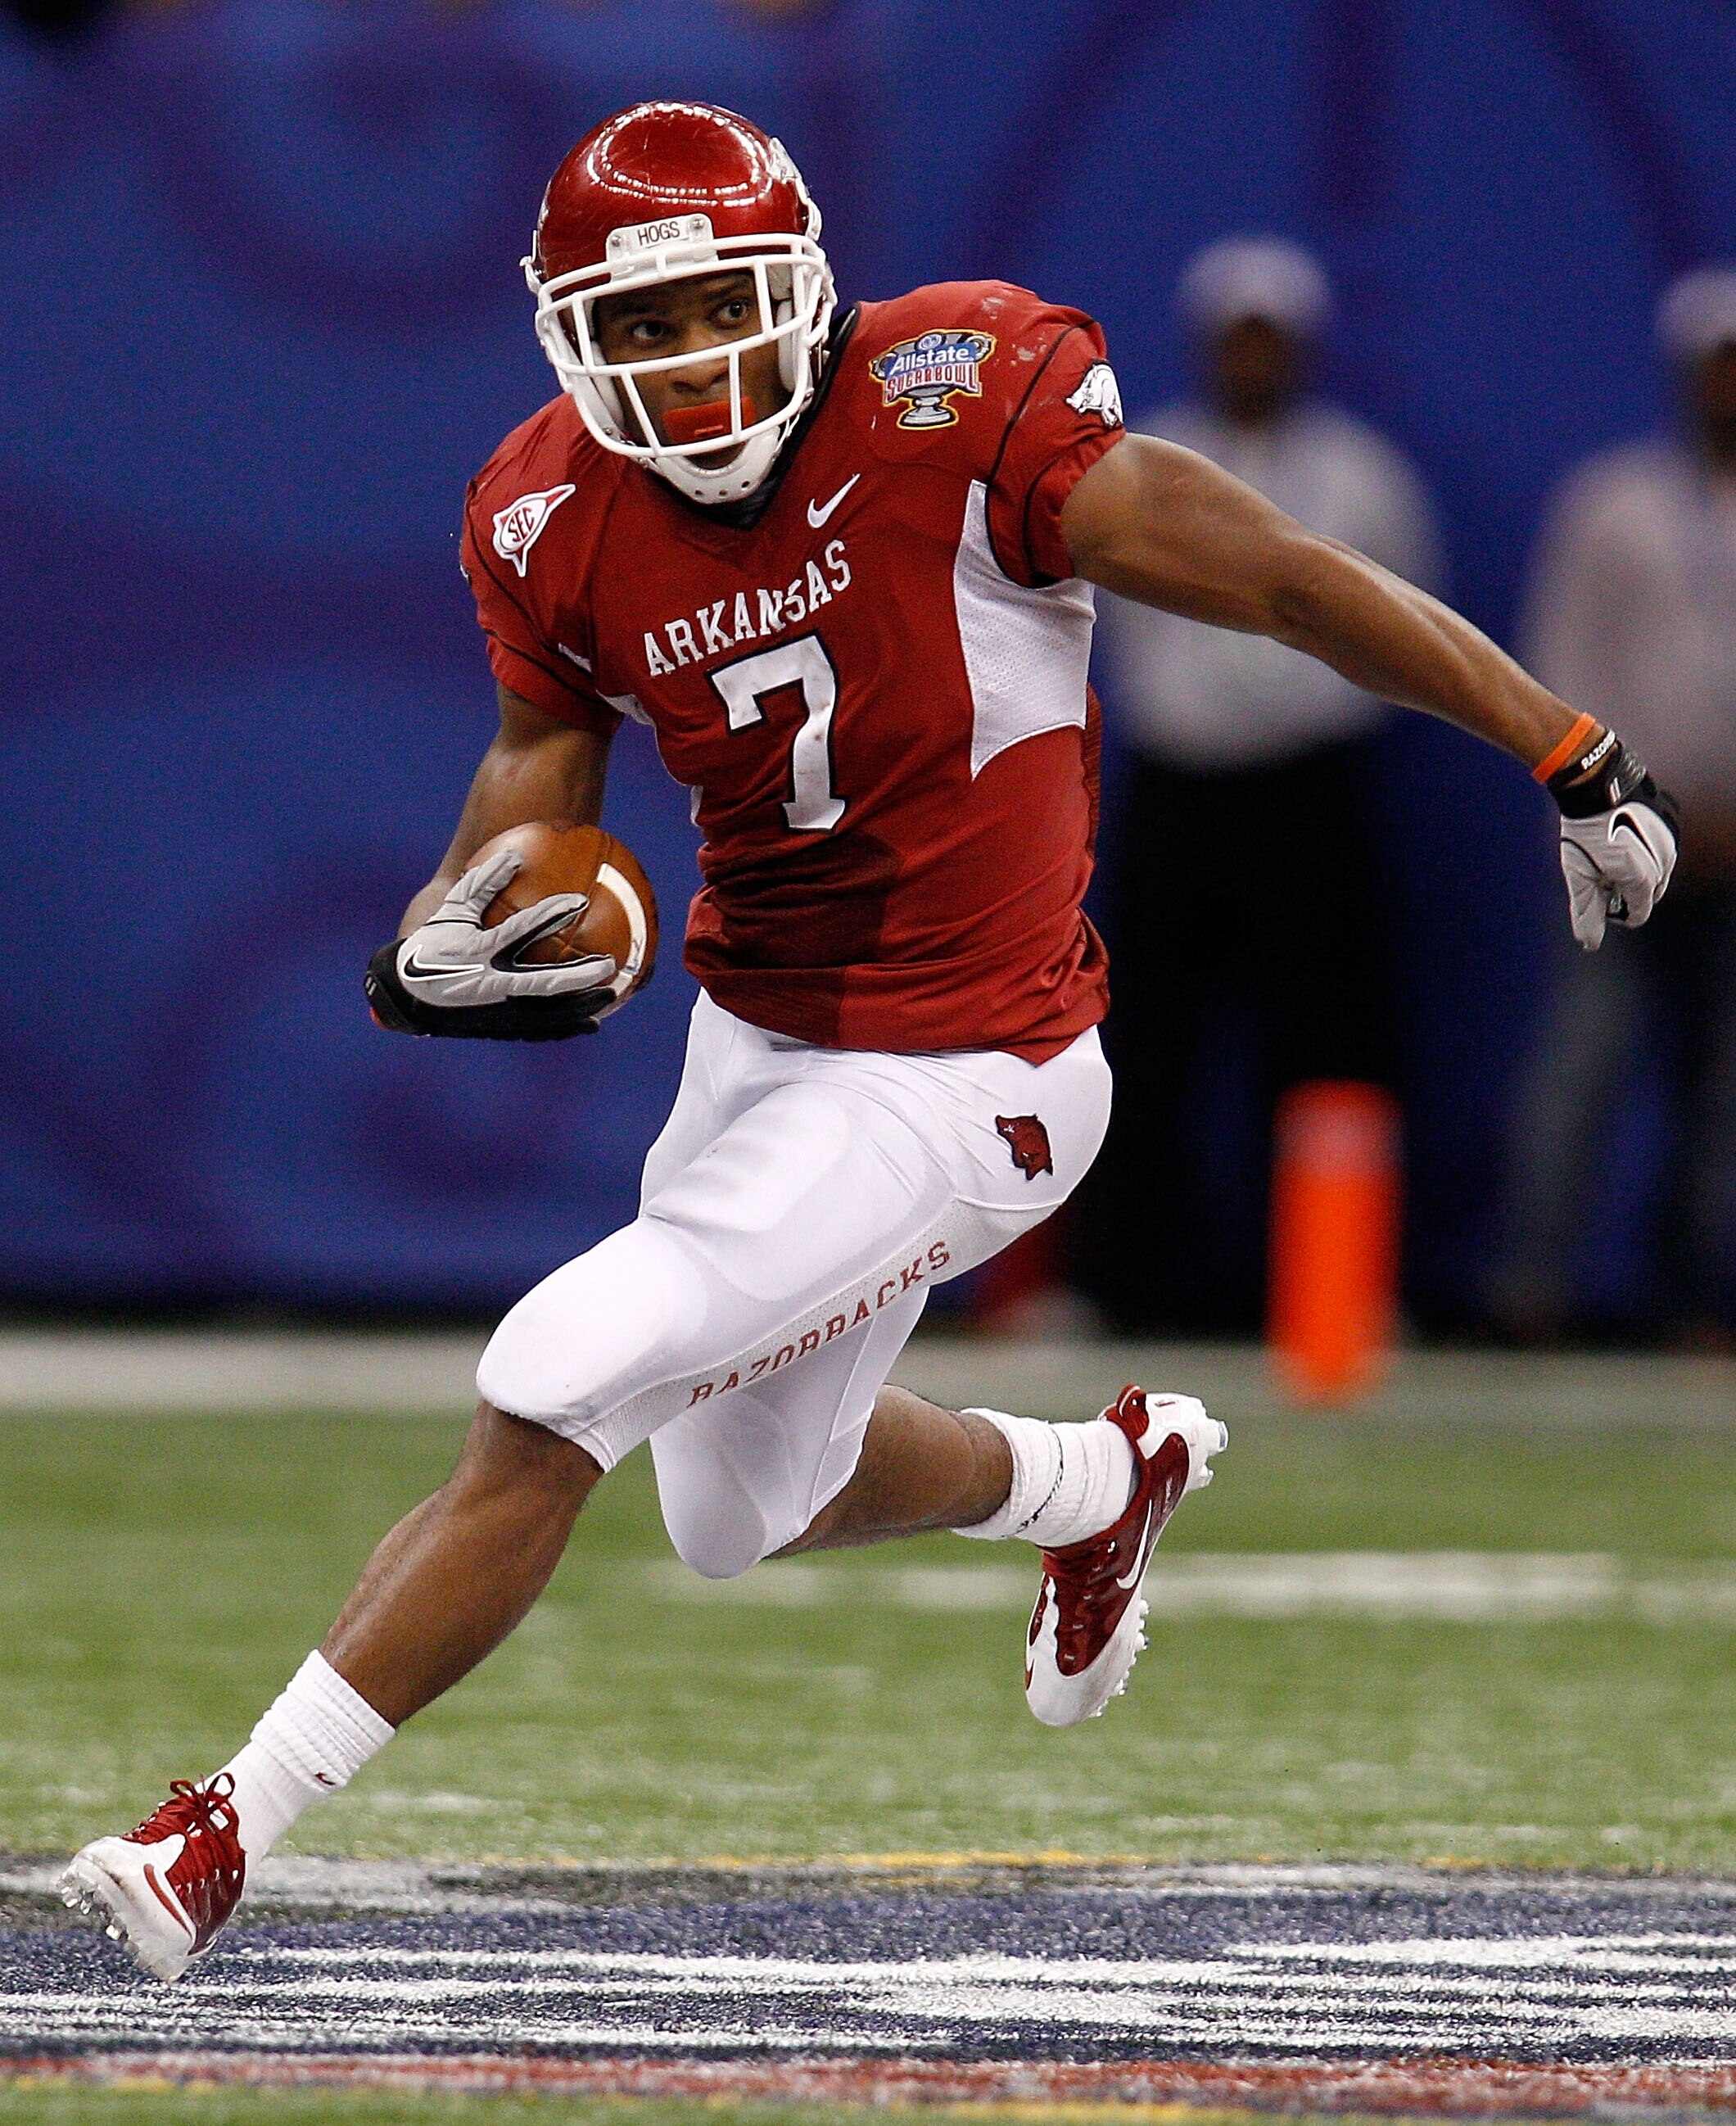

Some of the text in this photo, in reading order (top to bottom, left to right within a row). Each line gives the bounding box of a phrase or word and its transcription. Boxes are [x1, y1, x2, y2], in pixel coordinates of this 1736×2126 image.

[637, 221, 680, 246] HOGS
[889, 346, 970, 375] Allstate
[508, 507, 535, 542] SEC
[644, 539, 852, 676] ARKANSAS
[711, 634, 846, 830] 7
